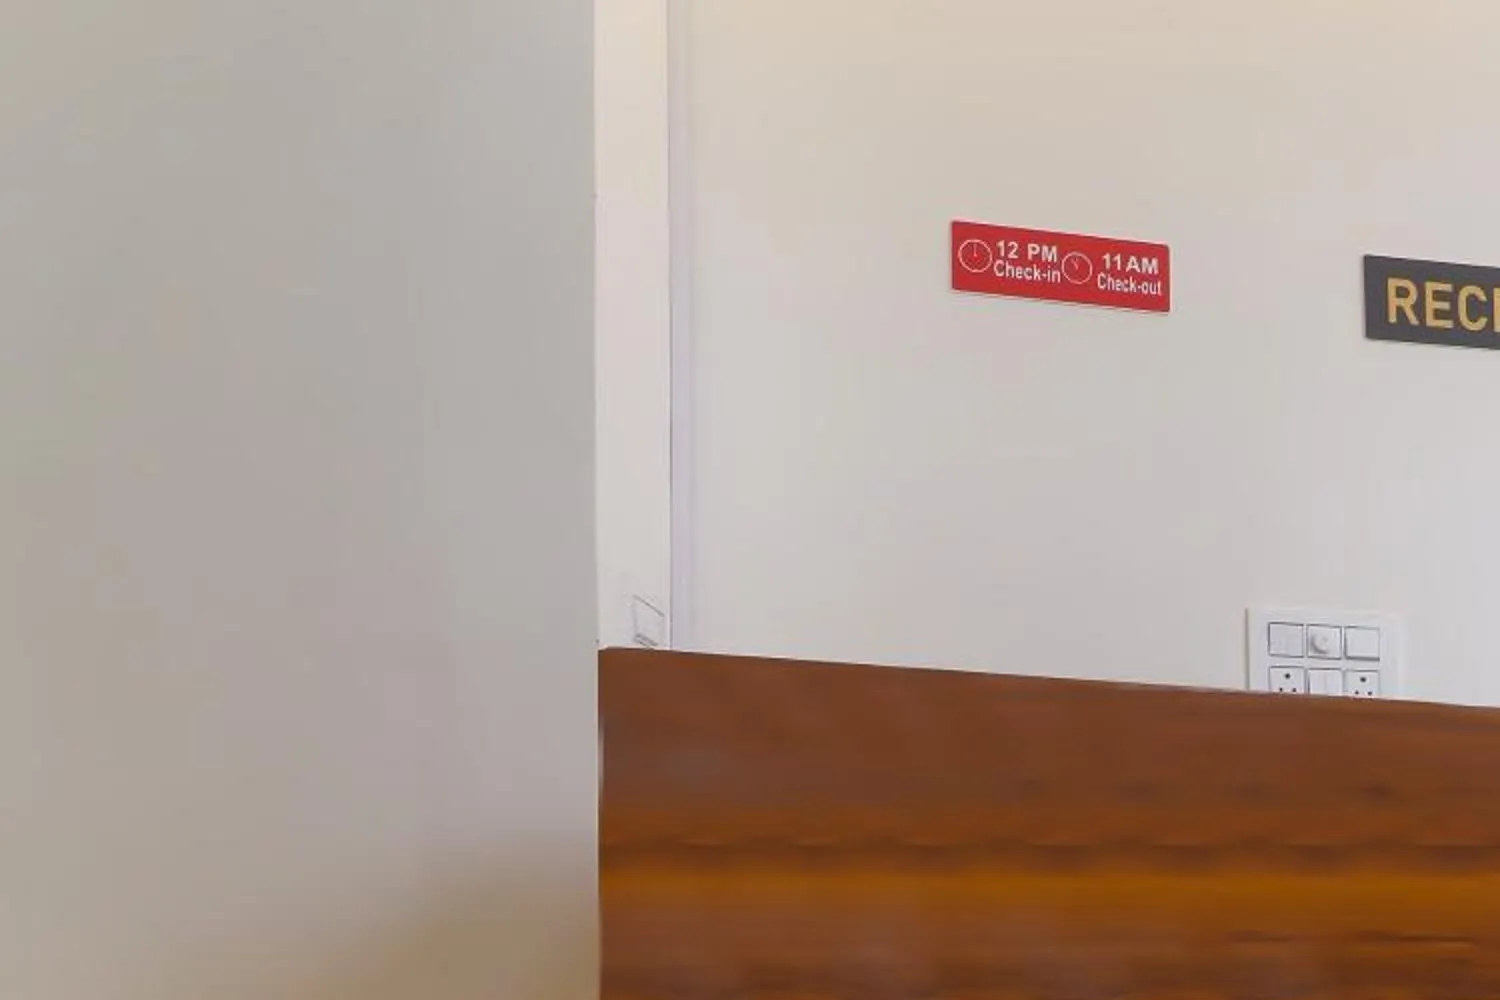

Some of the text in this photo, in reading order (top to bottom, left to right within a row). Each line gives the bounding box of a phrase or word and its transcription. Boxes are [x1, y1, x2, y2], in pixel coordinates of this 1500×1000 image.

[996, 240, 1058, 263] 12 PM
[993, 259, 1061, 284] Check-in
[1097, 272, 1162, 296] Check-out
